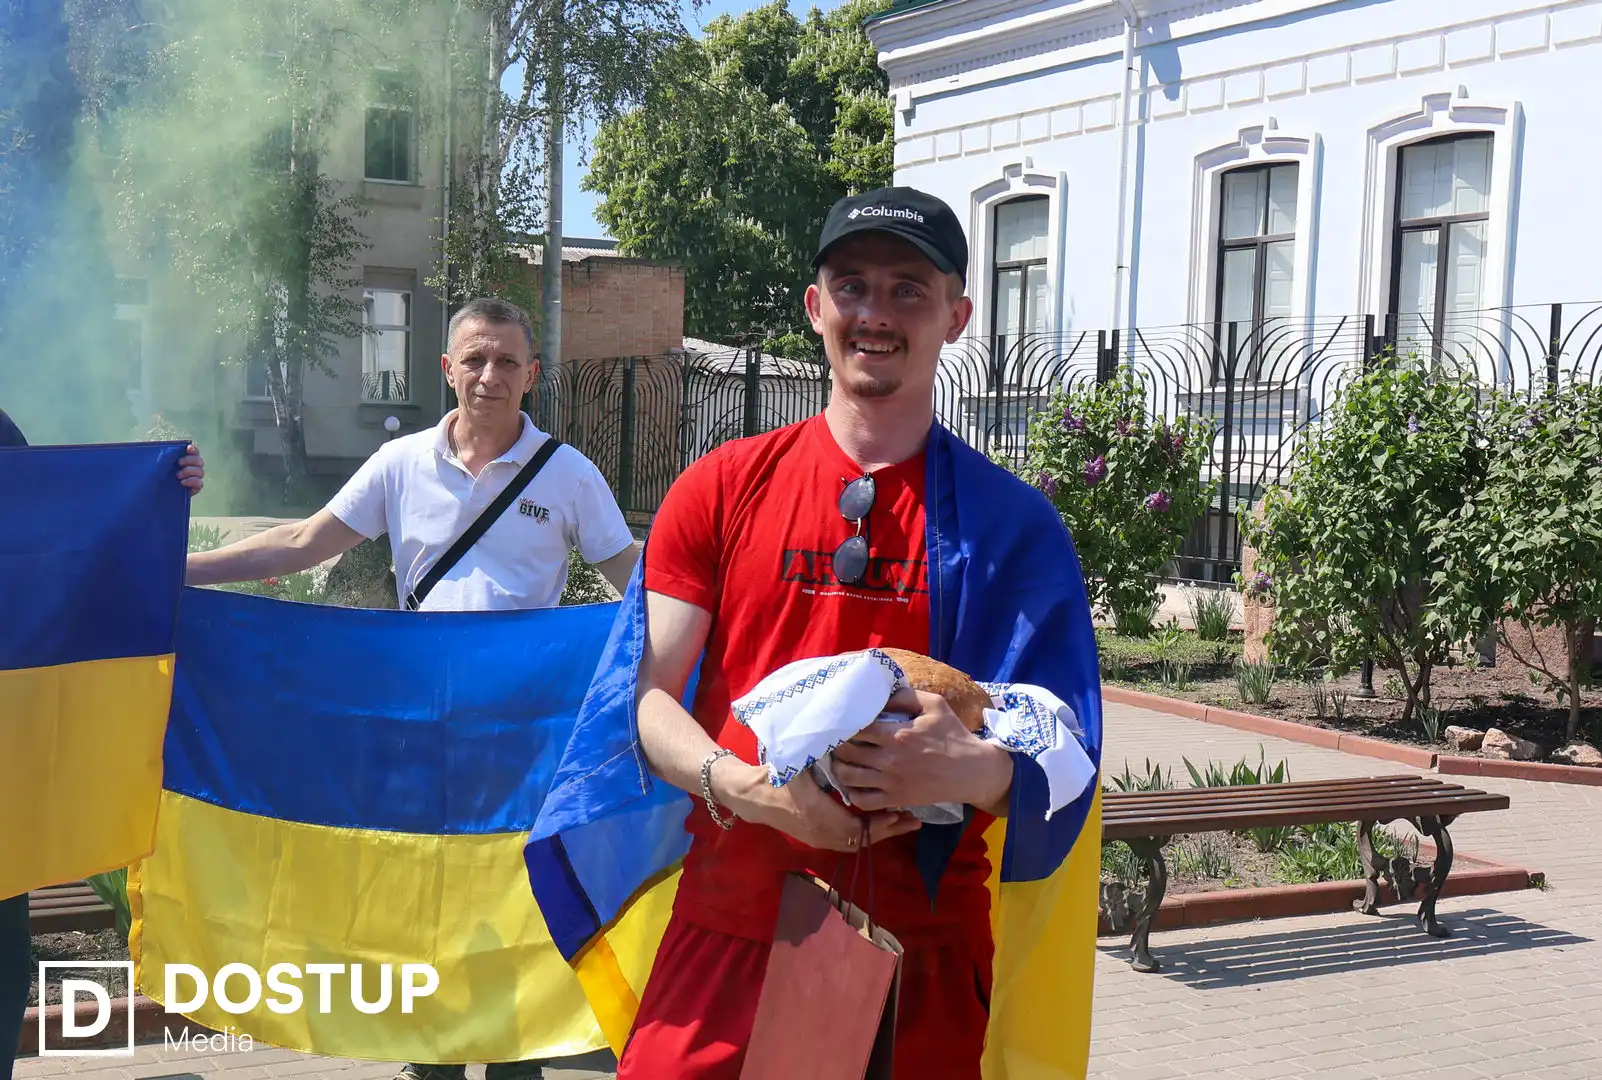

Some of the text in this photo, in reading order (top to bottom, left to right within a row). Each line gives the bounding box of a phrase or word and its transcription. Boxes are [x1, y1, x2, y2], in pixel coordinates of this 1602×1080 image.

[861, 206, 924, 223] Columbia
[519, 503, 550, 520] GIVE
[784, 550, 928, 593] ARUN
